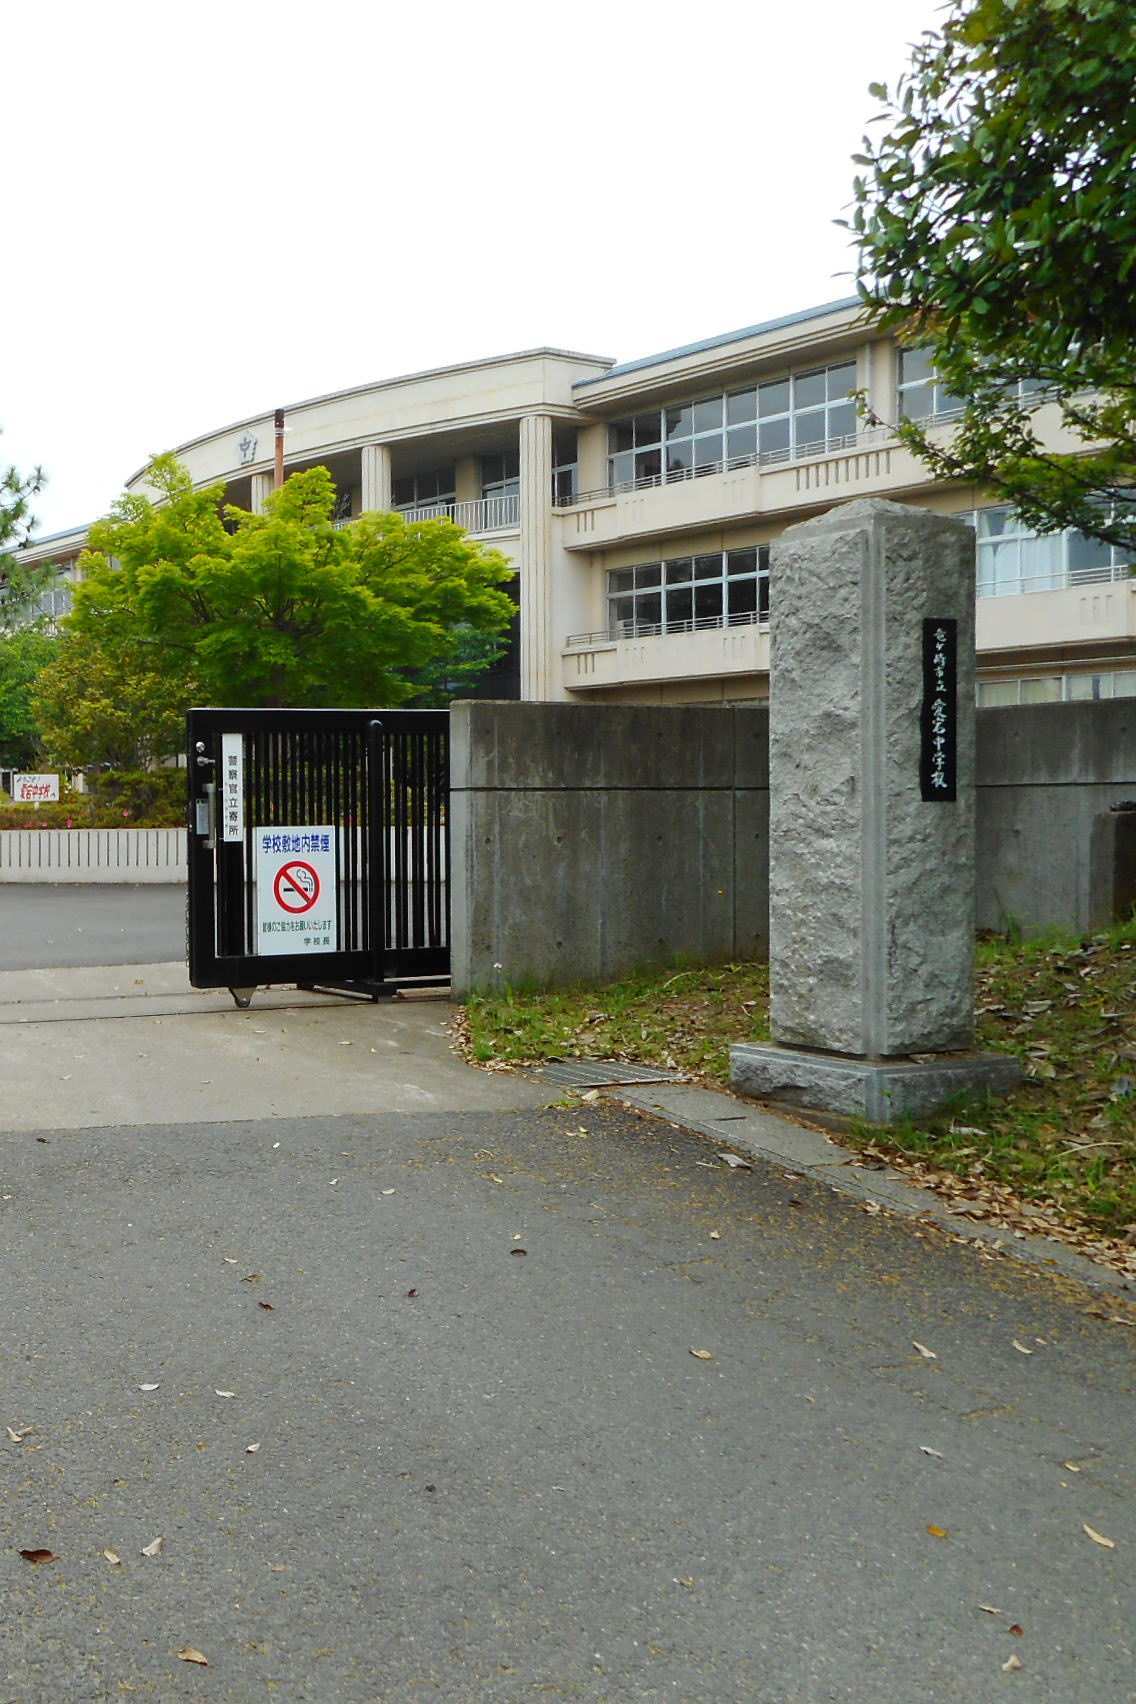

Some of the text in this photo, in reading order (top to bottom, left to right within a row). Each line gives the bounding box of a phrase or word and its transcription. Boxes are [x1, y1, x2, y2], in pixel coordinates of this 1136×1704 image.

[228, 755, 238, 836] 警察官立寄所
[262, 834, 330, 854] 学校敷地内禁煙
[303, 936, 331, 946] 学校長
